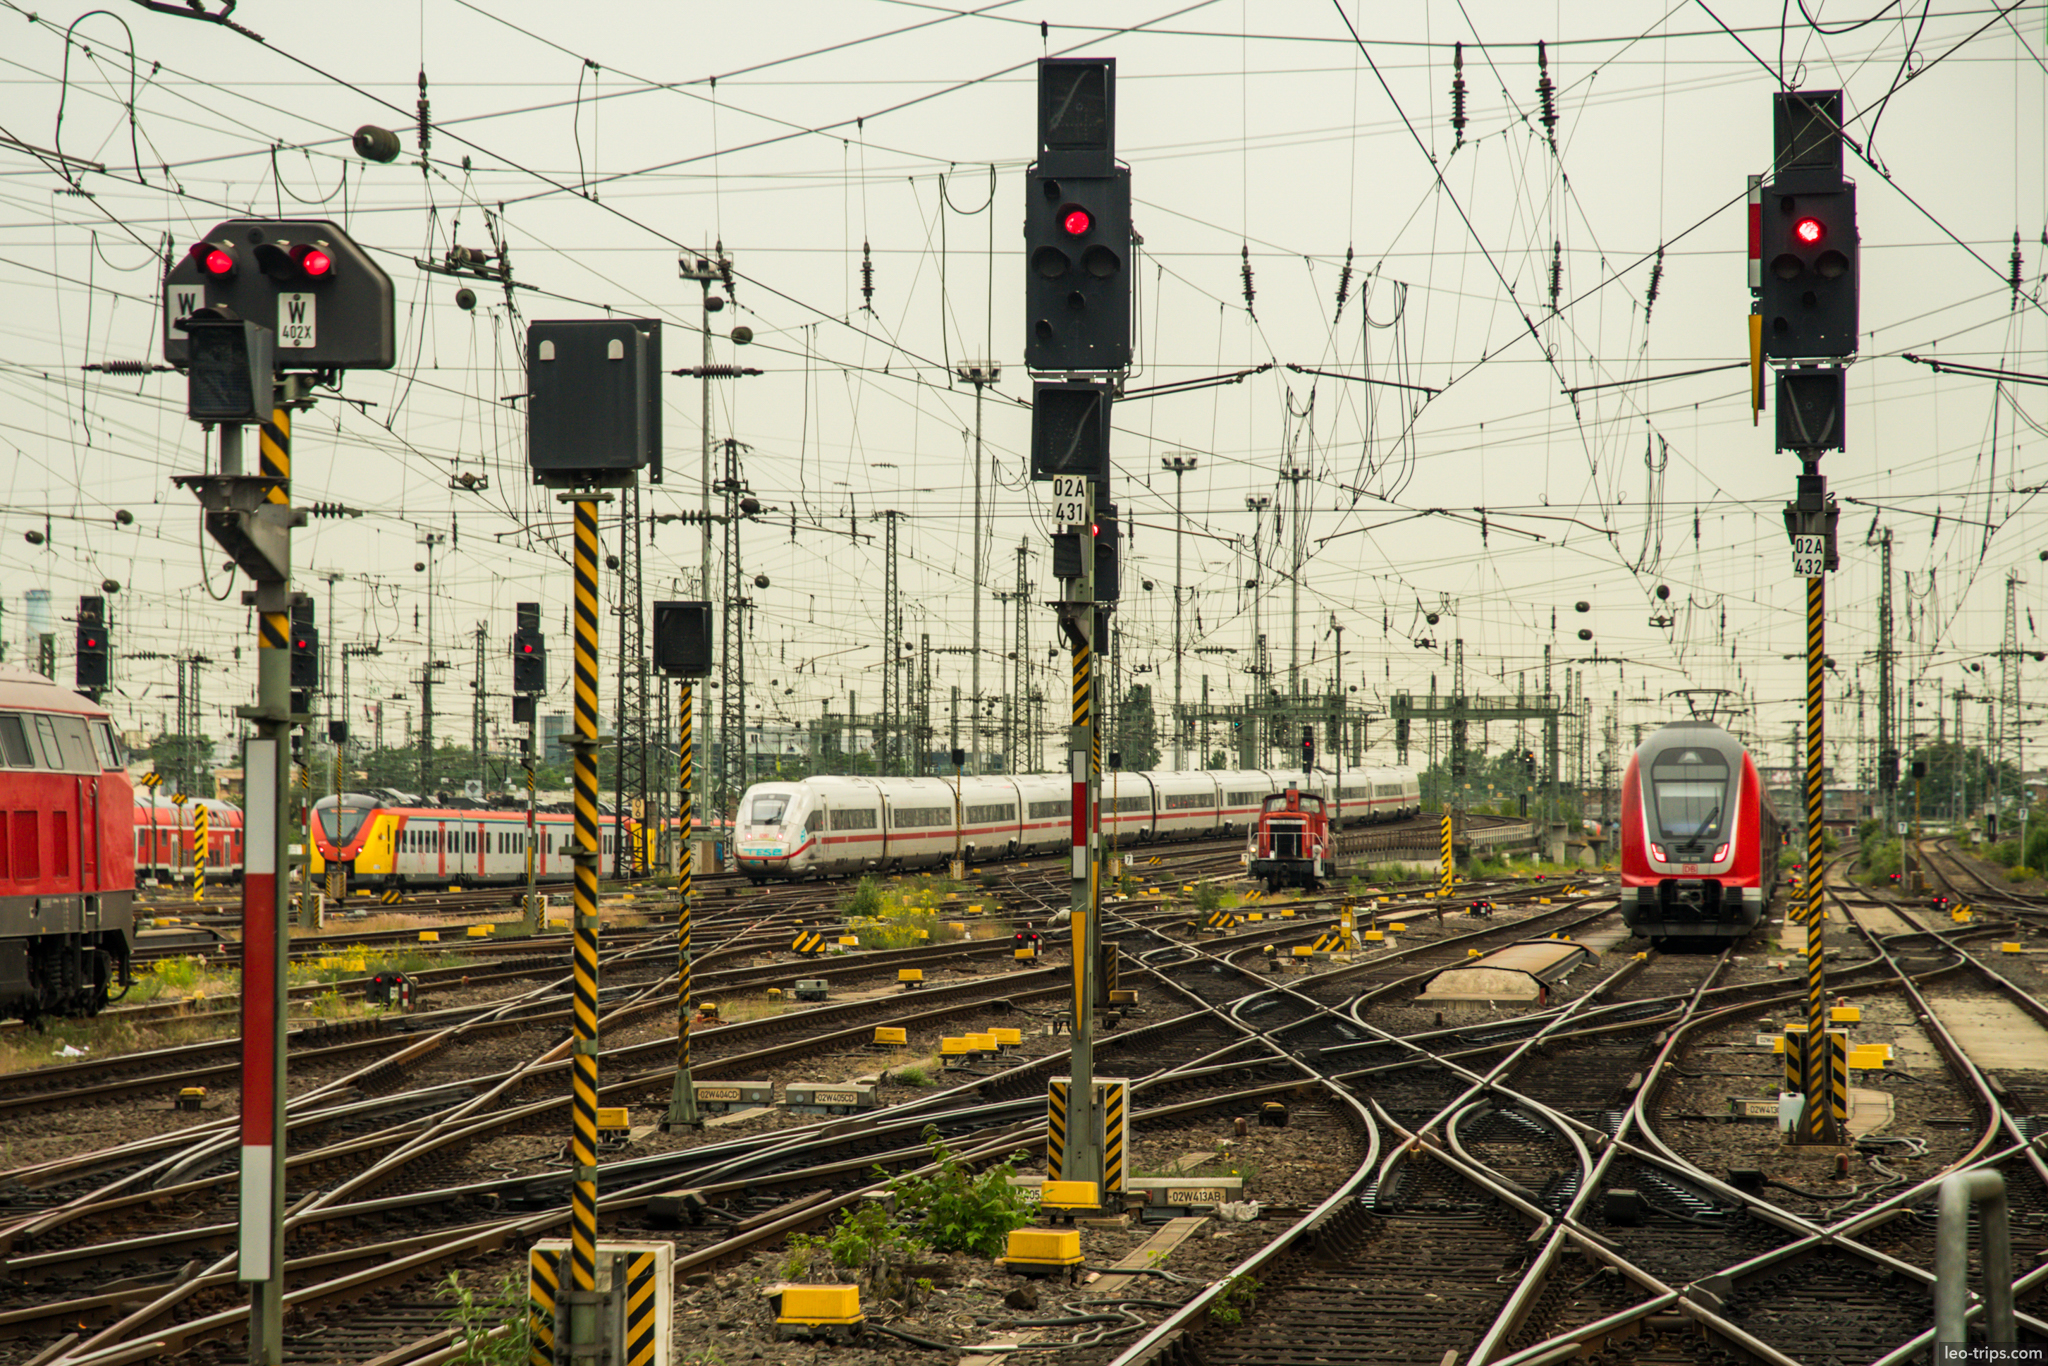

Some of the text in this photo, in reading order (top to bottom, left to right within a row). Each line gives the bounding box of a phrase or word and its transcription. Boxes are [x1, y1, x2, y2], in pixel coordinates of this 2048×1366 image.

[178, 293, 196, 316] W
[288, 301, 306, 324] W
[282, 325, 312, 339] 402X
[1054, 478, 1085, 498] 02A
[1055, 502, 1083, 521] 431
[1795, 538, 1823, 554] 02A
[1794, 558, 1822, 574] 432
[1683, 864, 1698, 873] DB
[700, 1090, 738, 1099] 02W404CD
[1173, 1191, 1221, 1202] 02W413AB
